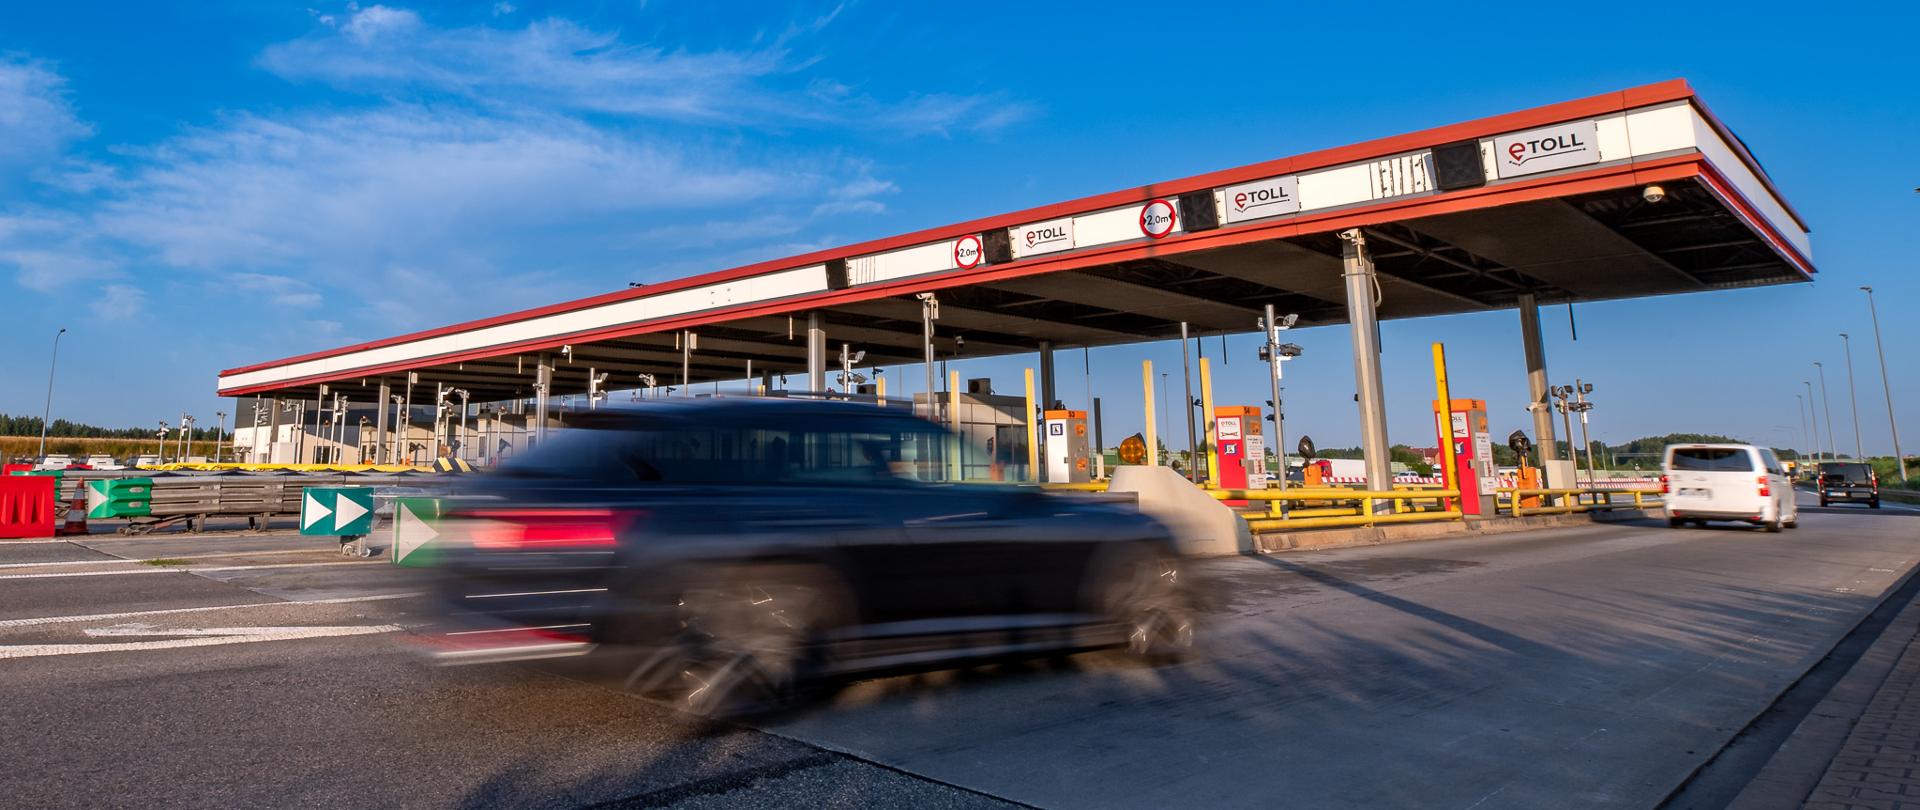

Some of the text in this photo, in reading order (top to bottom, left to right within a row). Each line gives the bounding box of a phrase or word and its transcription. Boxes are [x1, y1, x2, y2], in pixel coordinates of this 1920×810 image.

[1509, 133, 1584, 162] eTOLL
[1235, 187, 1289, 209] eTOLL
[1026, 227, 1066, 245] eTOLL
